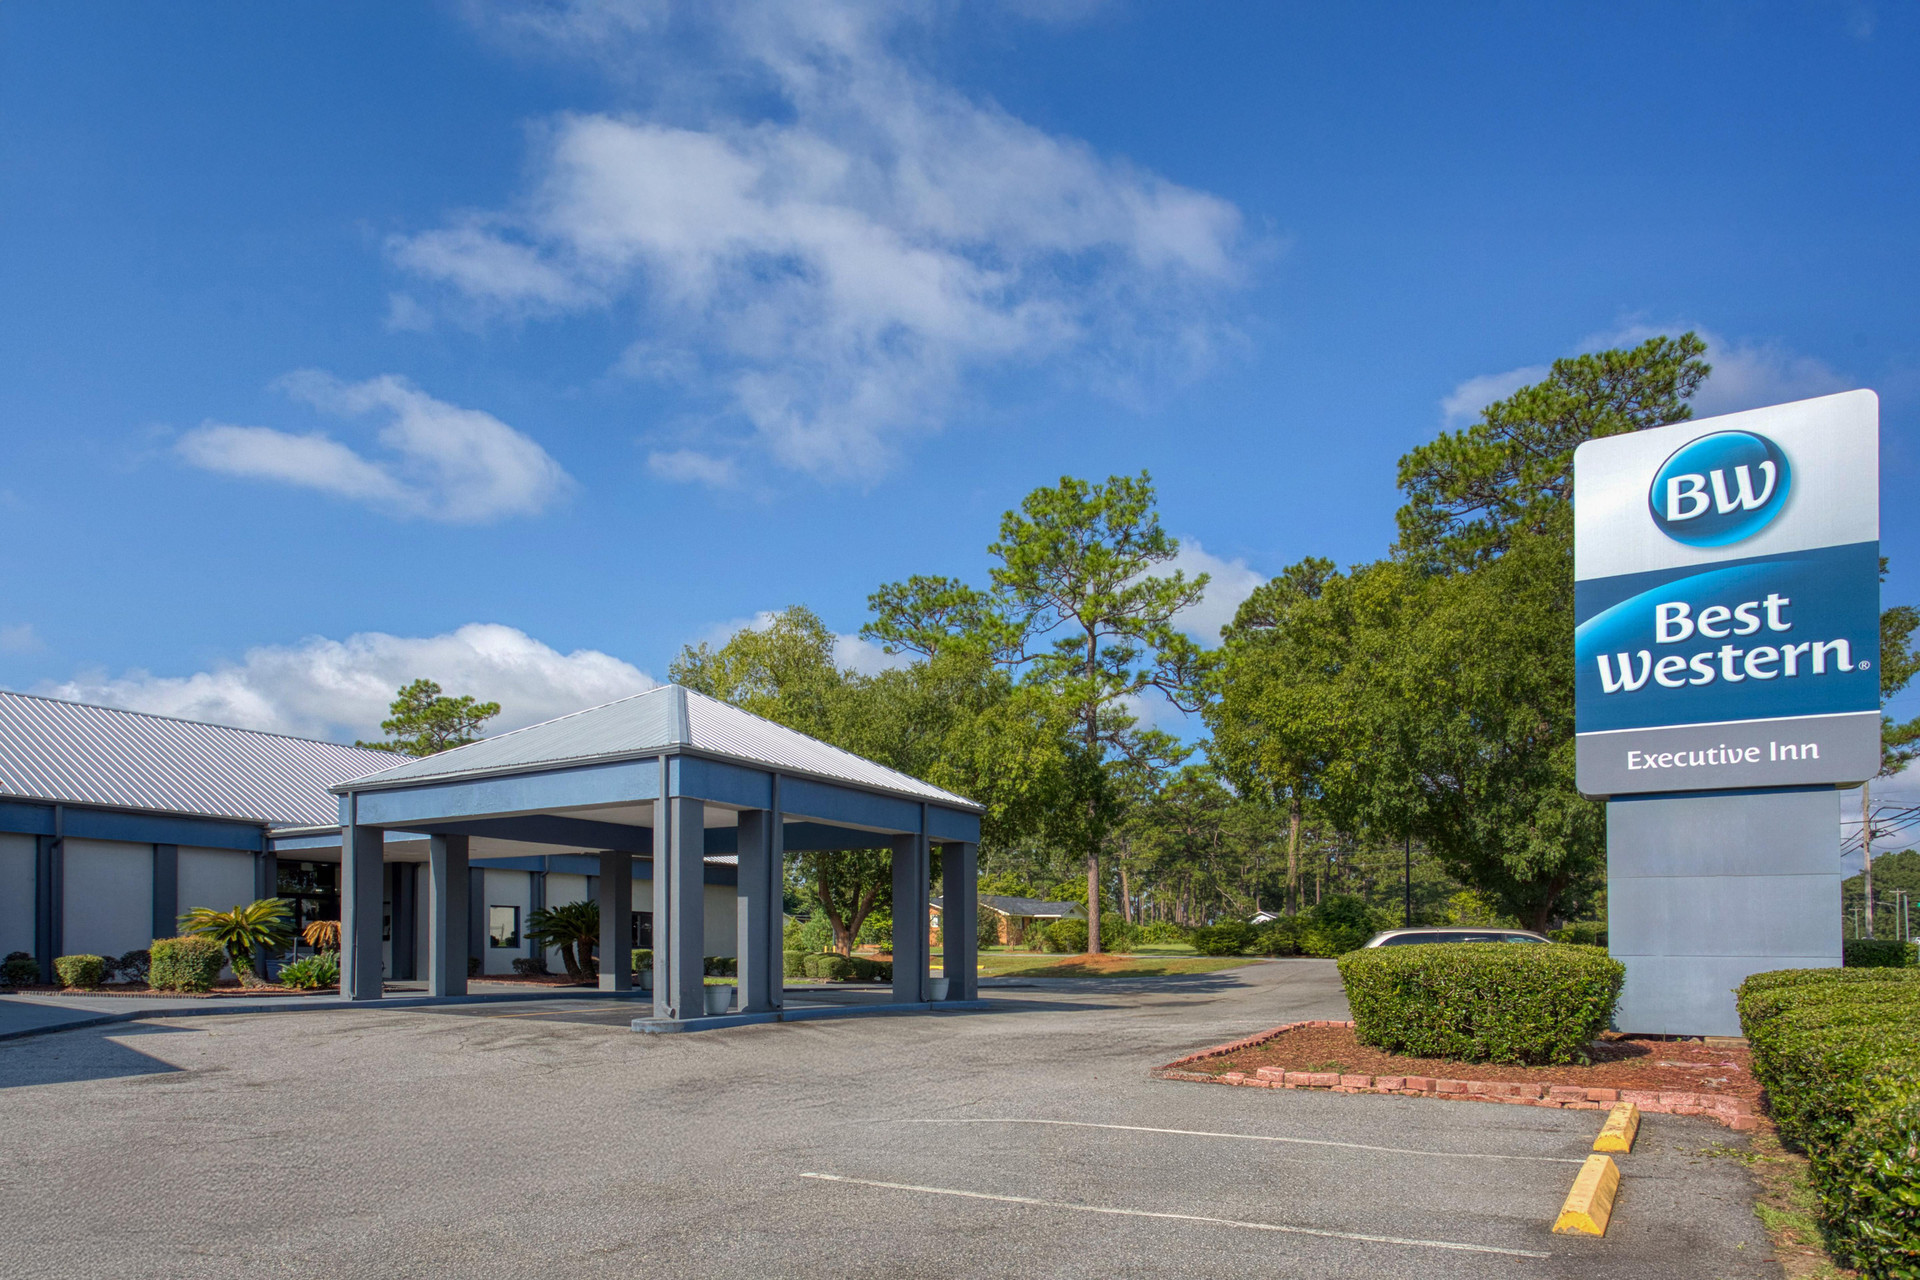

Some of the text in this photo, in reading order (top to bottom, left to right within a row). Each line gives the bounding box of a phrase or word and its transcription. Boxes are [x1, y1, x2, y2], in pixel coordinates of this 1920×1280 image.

[1666, 460, 1776, 521] BW
[1655, 593, 1791, 643] Best
[1627, 741, 1820, 770] Executive Inn
